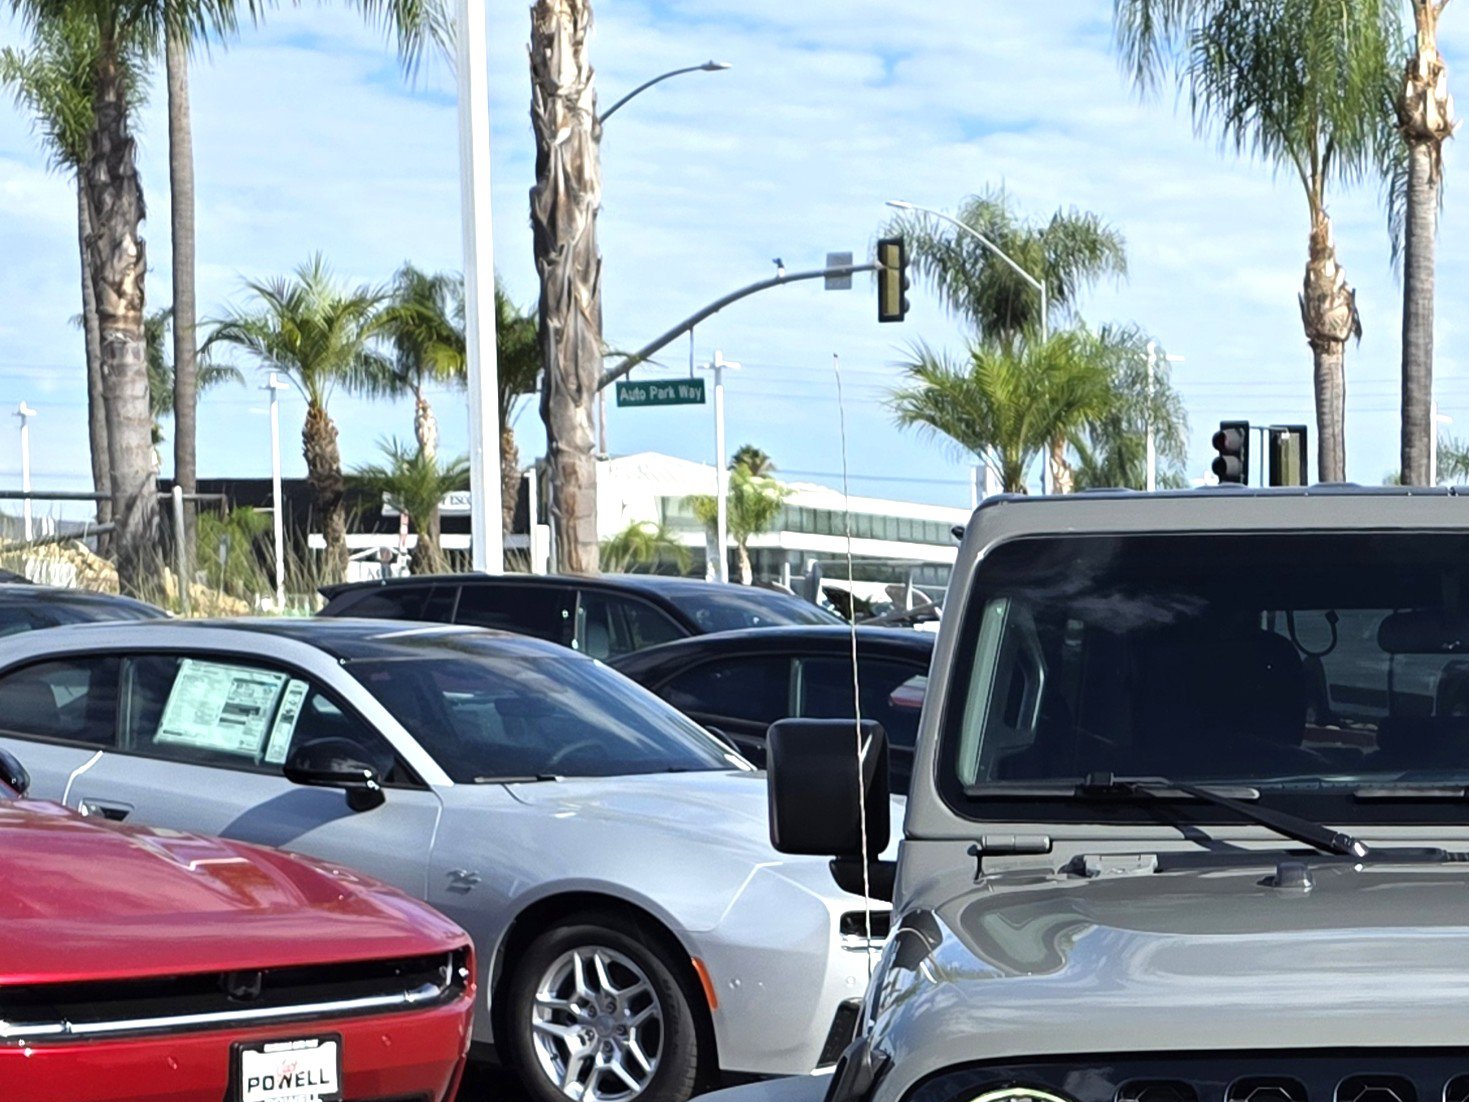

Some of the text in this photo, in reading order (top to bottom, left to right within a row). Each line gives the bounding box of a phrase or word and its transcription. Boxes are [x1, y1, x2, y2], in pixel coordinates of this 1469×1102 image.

[620, 383, 702, 401] Auto Park Way
[247, 1068, 330, 1093] POWELL
